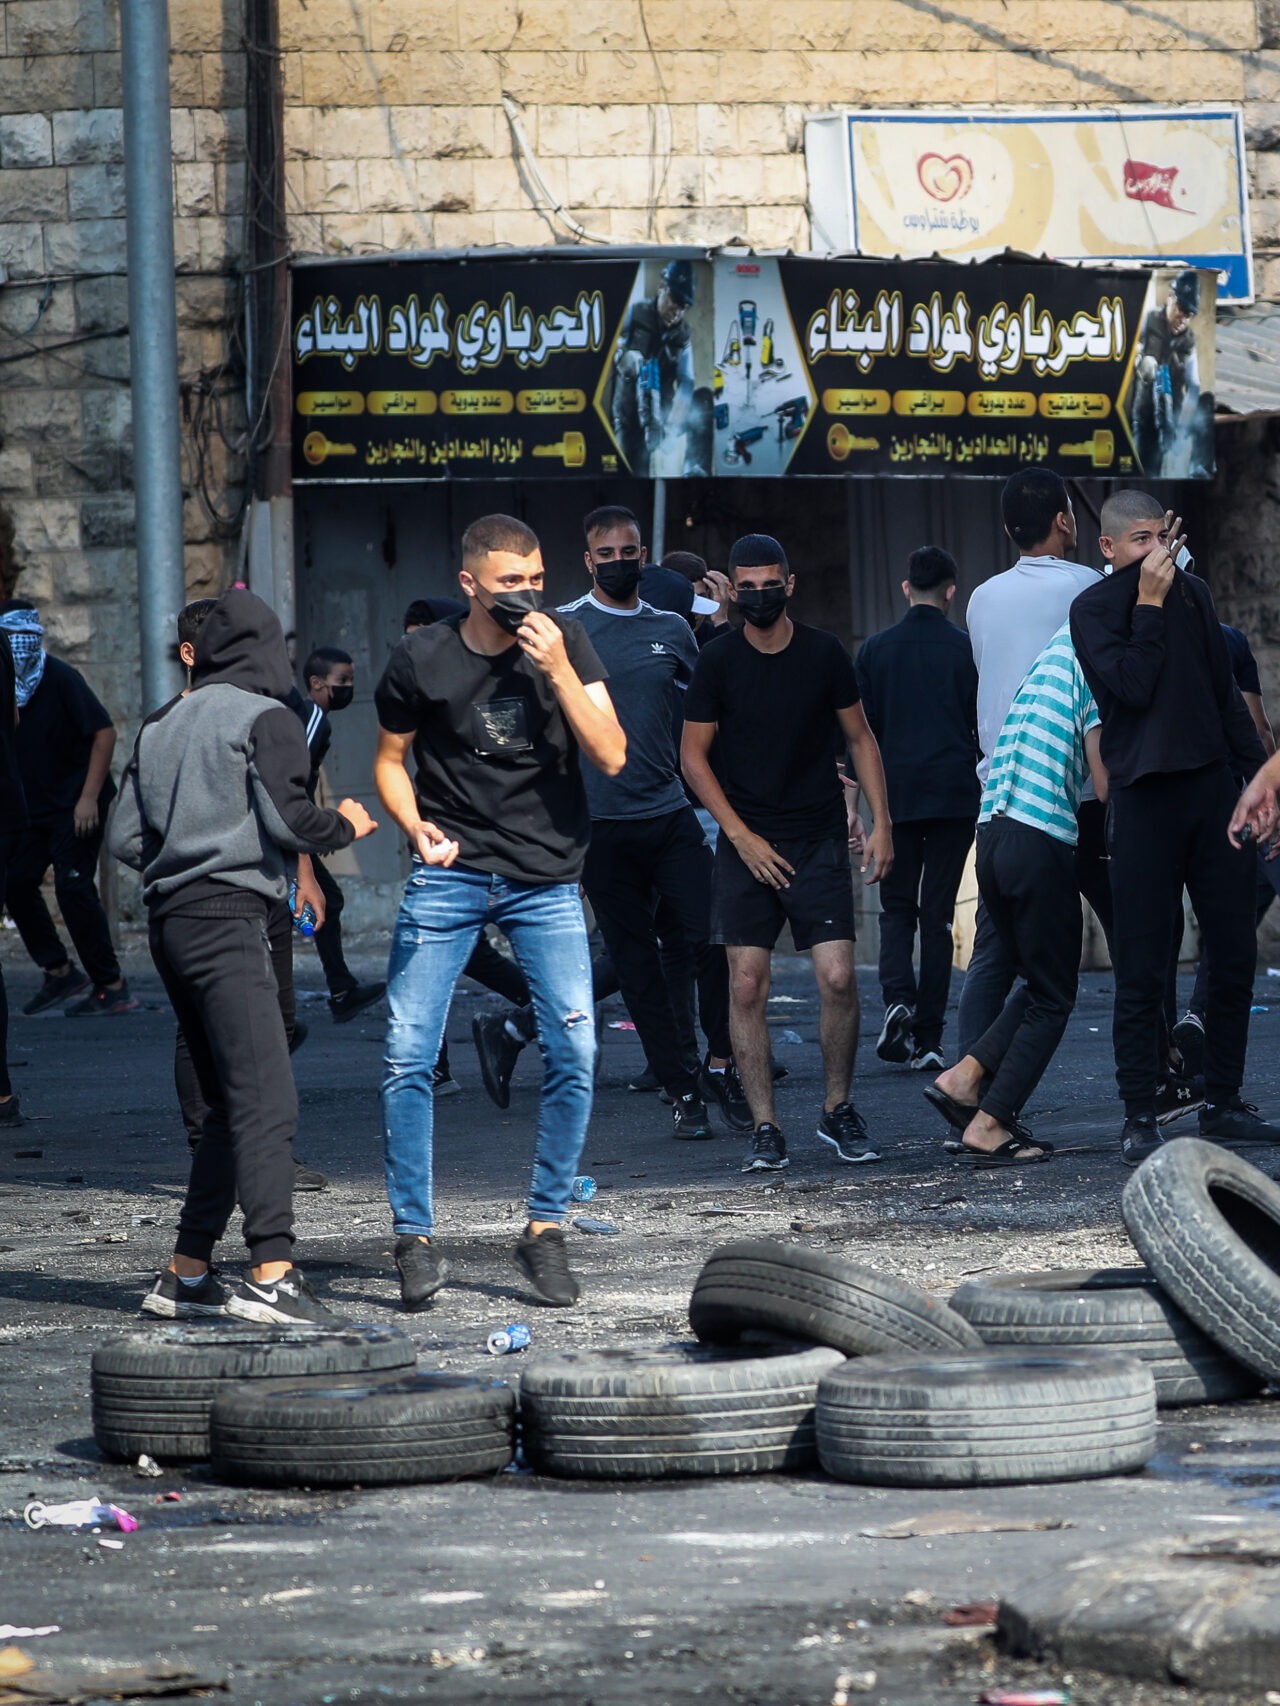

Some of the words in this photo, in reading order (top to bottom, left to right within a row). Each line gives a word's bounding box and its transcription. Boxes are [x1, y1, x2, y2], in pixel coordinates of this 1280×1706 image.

[296, 295, 381, 372] البناء
[387, 293, 451, 369] لمواد
[455, 291, 604, 374] الحرباوي
[806, 288, 903, 375] البناء
[906, 291, 974, 373] لمواد
[976, 293, 1126, 381] الحرباوي
[430, 437, 490, 464] الحدادين
[492, 438, 523, 464] لوازم
[889, 432, 952, 462] والنجارين
[955, 433, 1017, 462] الحدادين
[1018, 432, 1049, 461] لوازم
